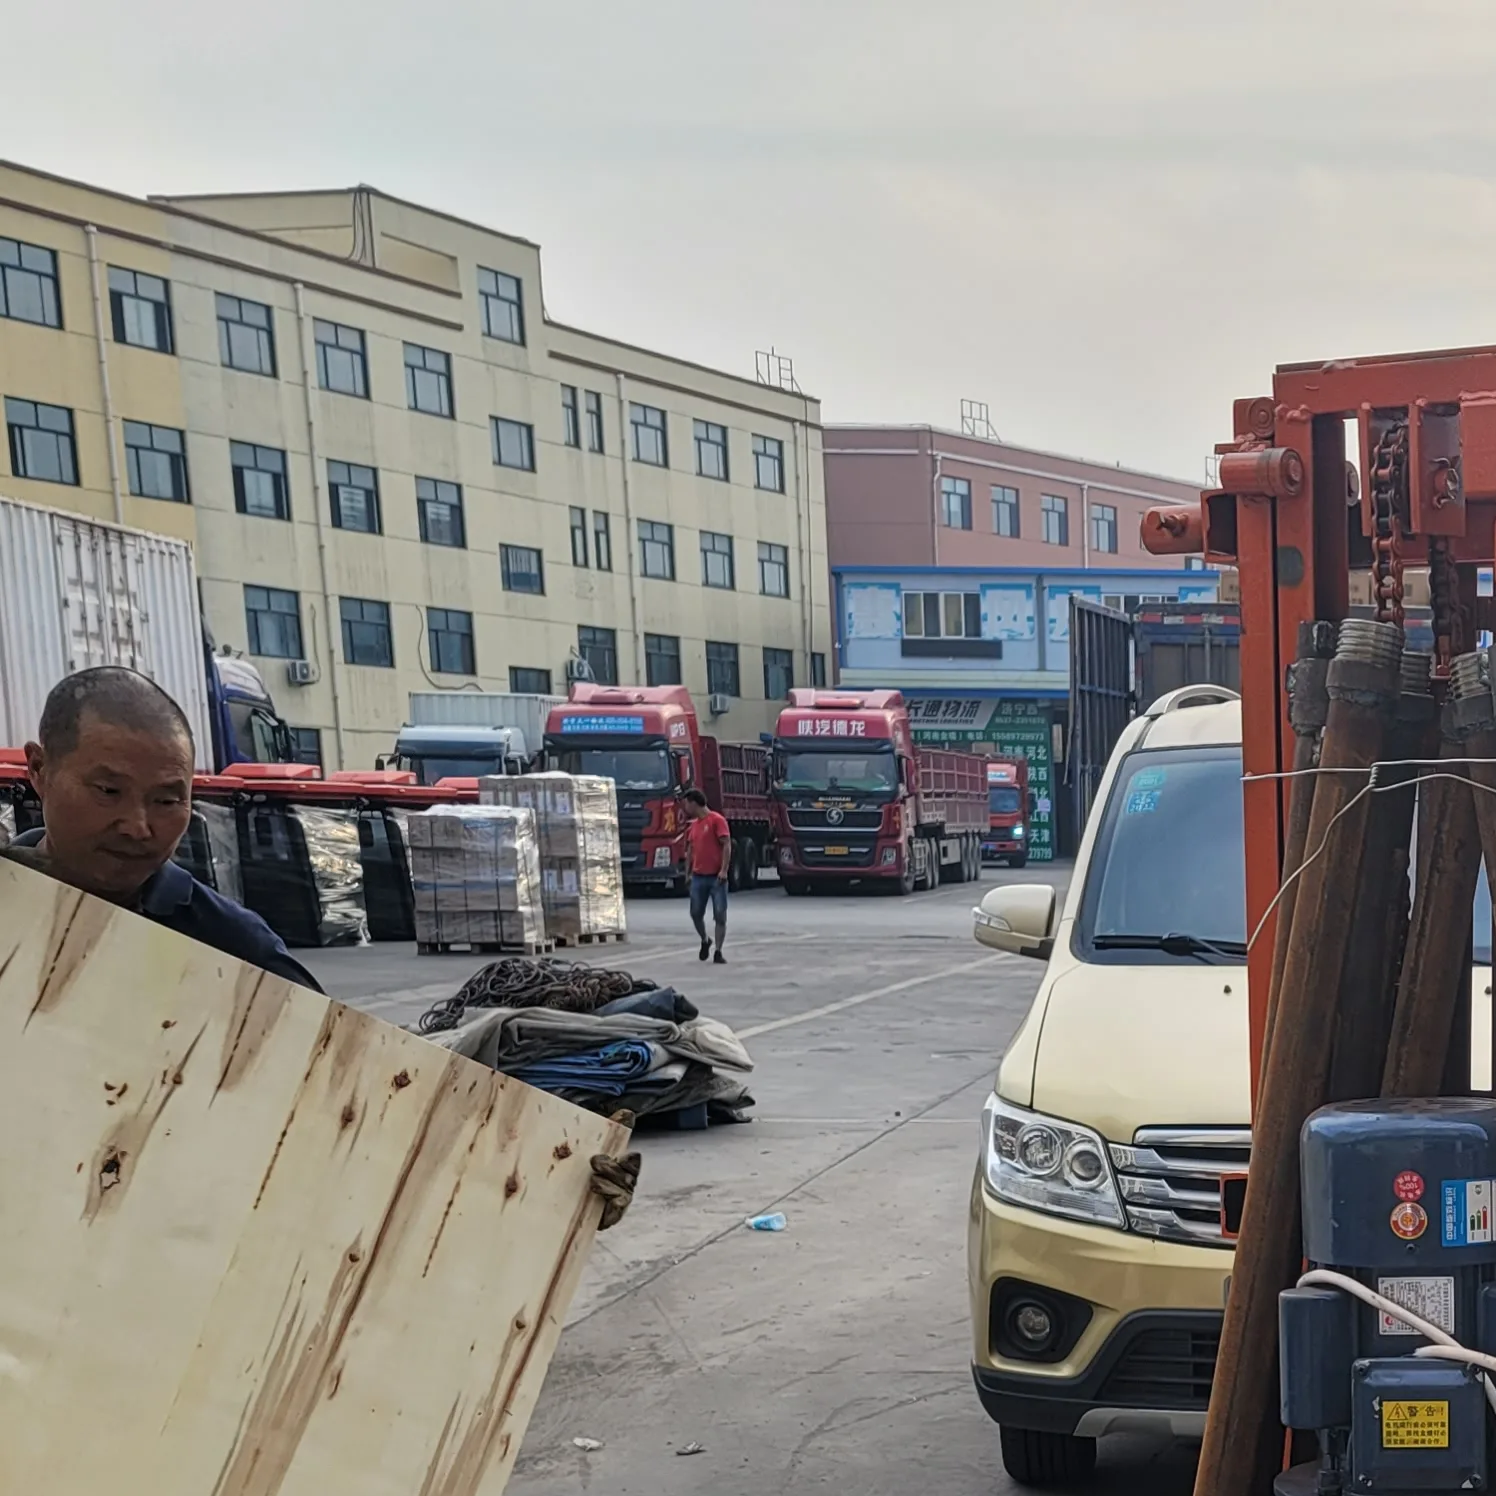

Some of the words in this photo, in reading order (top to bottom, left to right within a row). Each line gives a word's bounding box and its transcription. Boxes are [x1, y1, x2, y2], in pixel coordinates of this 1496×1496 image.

[798, 719, 866, 737] 陕汽德龙
[1026, 745, 1048, 760] 河北
[1030, 829, 1050, 843] 天津
